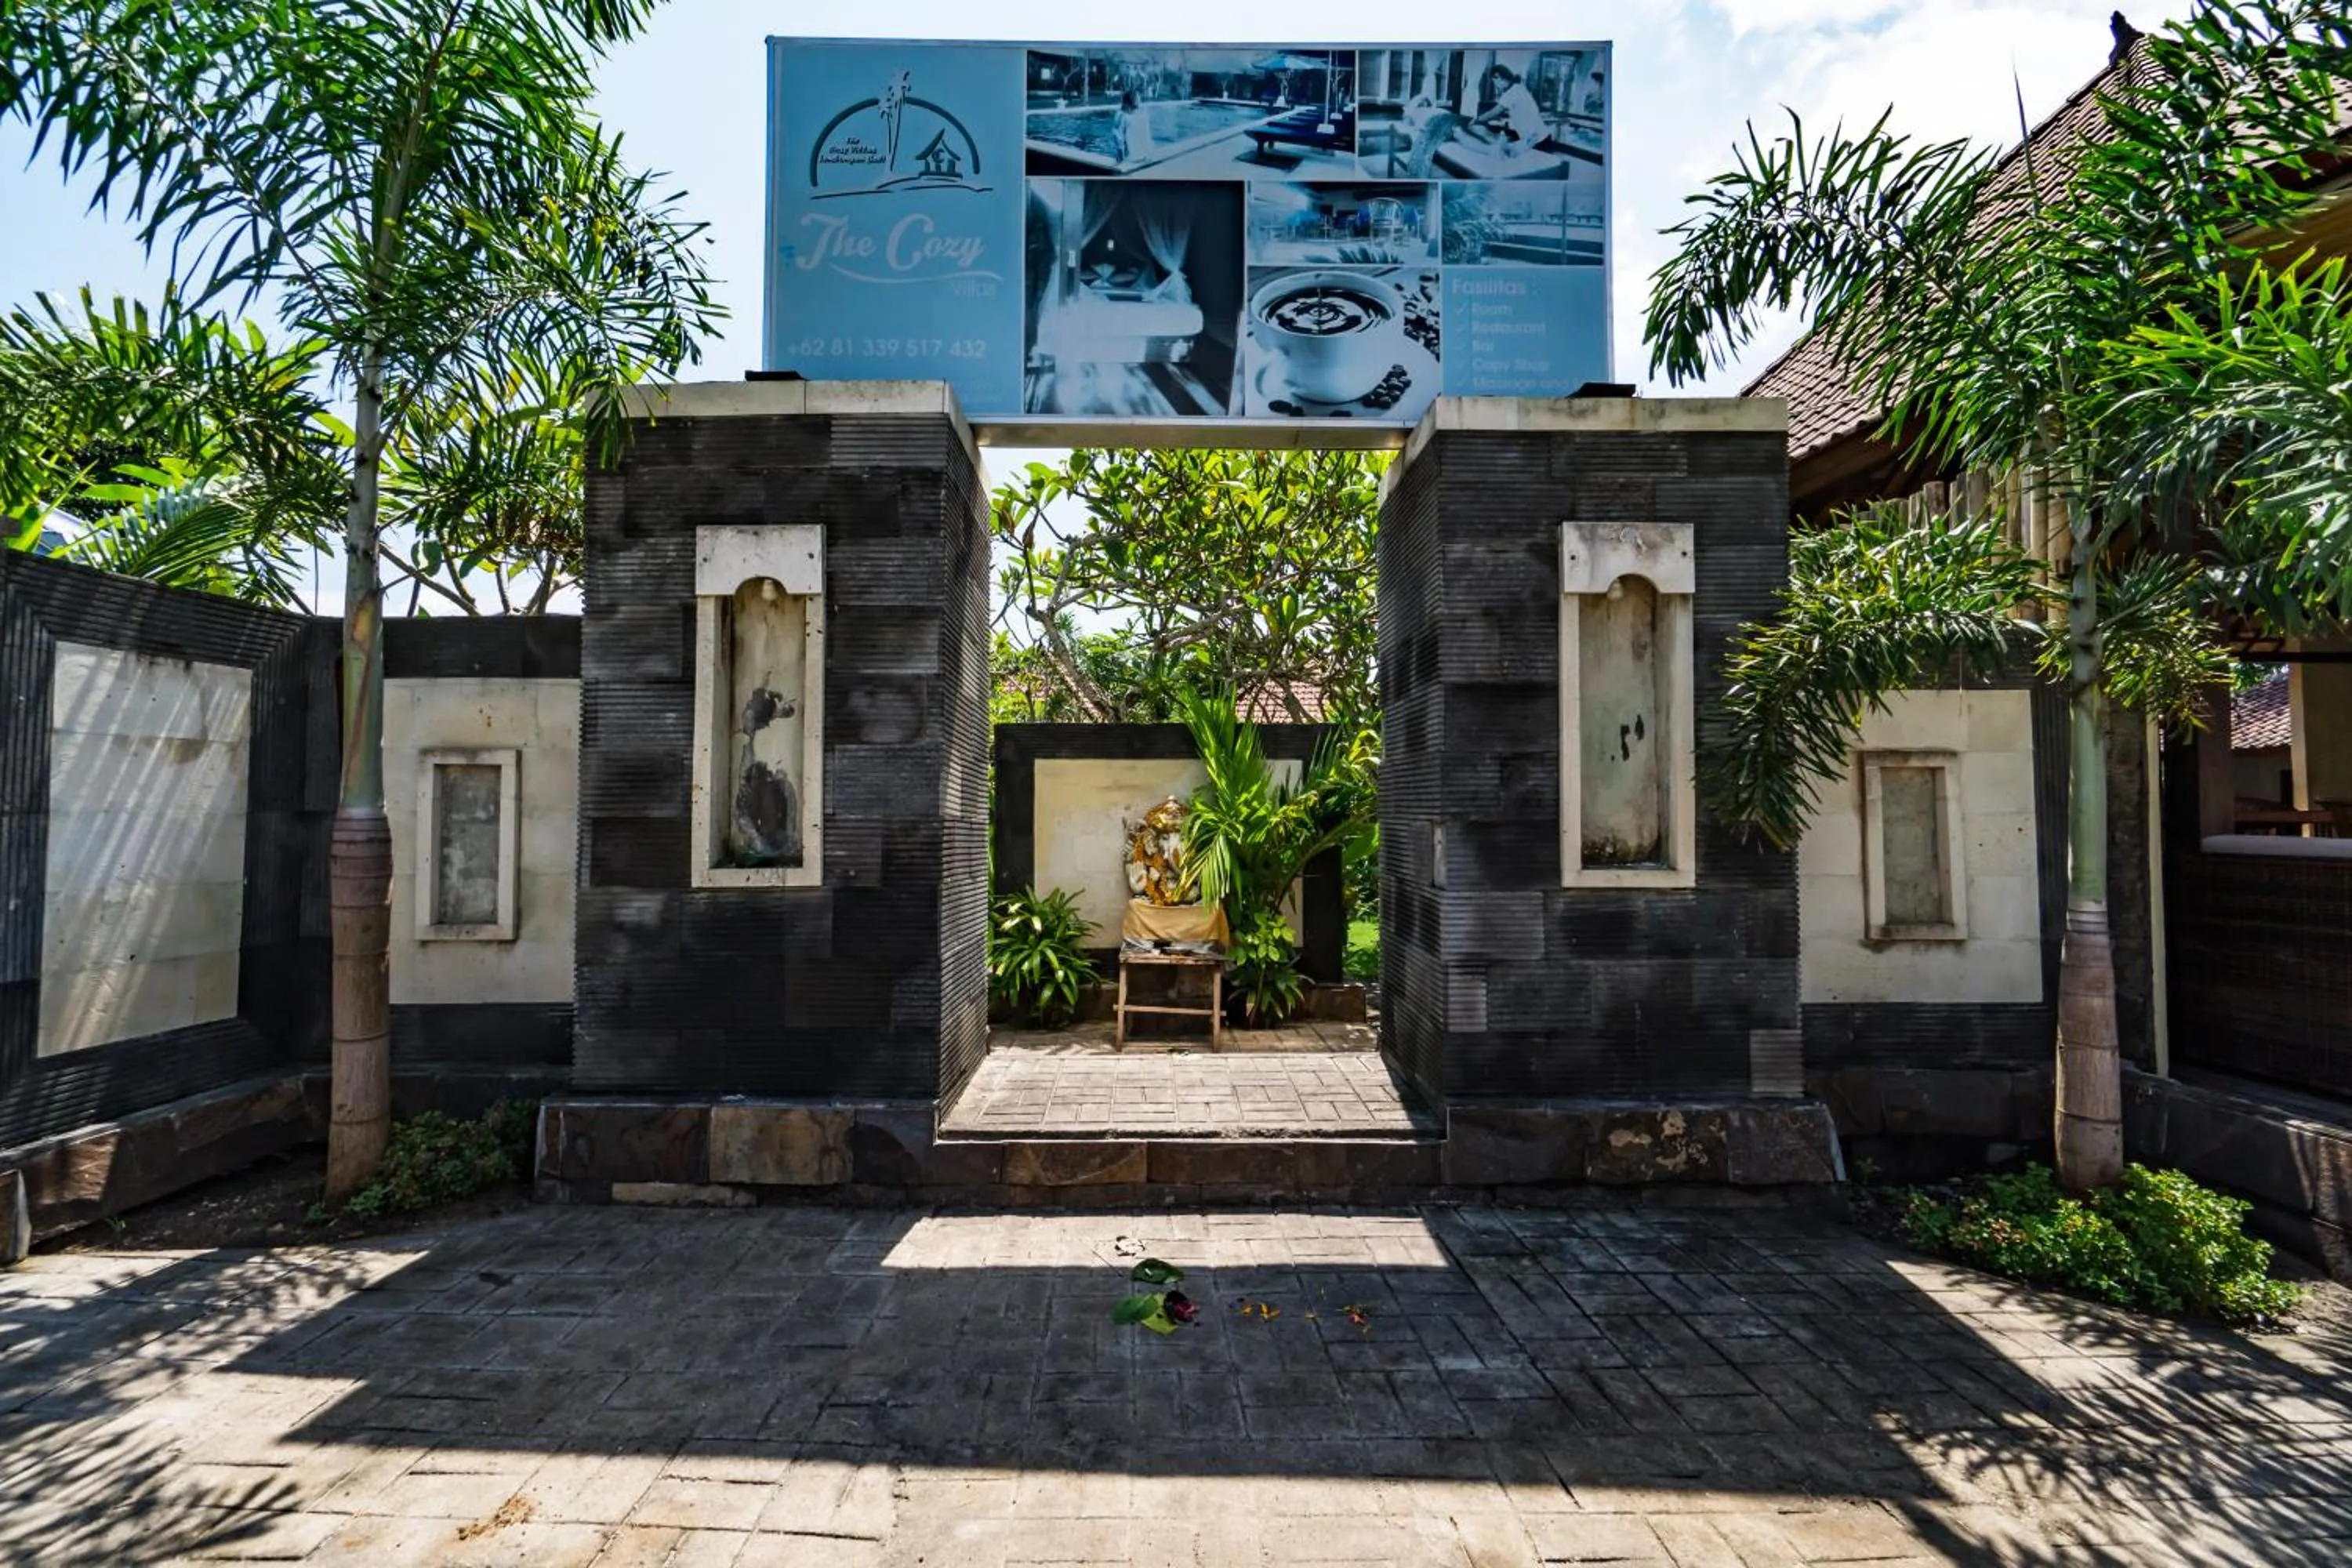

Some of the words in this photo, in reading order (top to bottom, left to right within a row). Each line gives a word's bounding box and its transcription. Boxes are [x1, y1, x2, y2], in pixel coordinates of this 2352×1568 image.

[794, 212, 877, 270] The
[885, 212, 986, 271] Cozy
[1452, 278, 1526, 296] Fasilitas
[1472, 321, 1546, 335] Restaurant
[787, 338, 825, 358] +62
[831, 338, 852, 357] 81
[862, 338, 899, 358] 339
[905, 338, 943, 358] 517
[949, 338, 987, 358] 432
